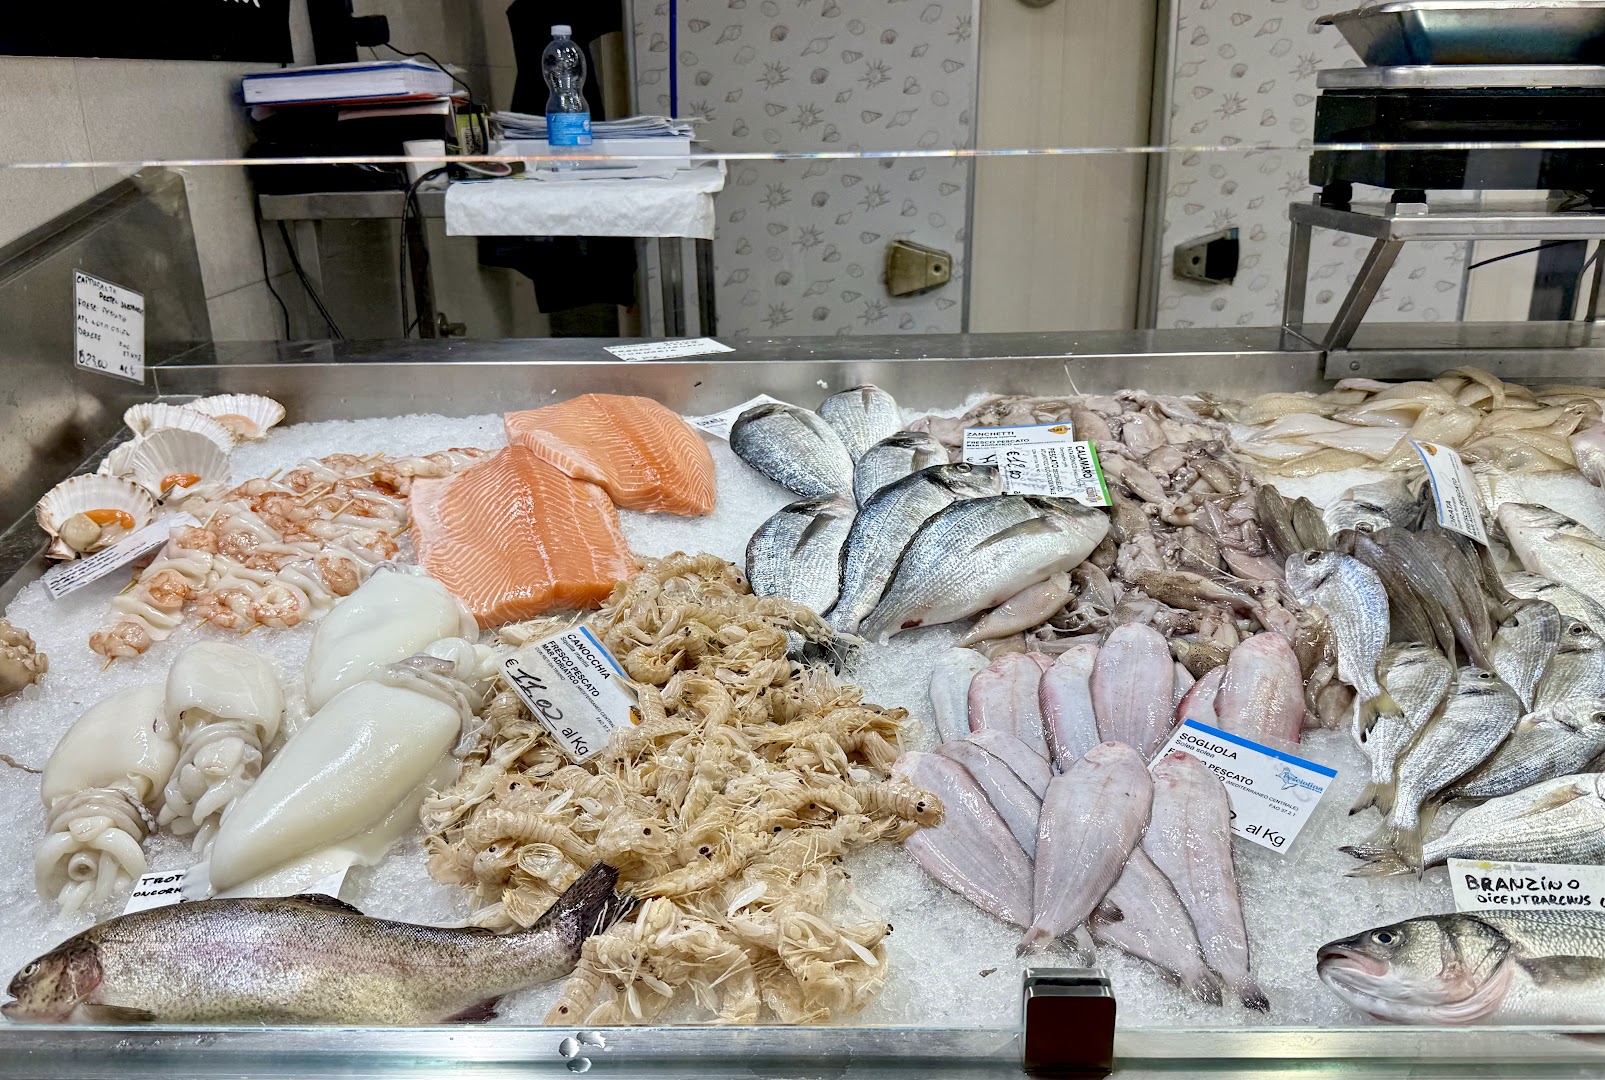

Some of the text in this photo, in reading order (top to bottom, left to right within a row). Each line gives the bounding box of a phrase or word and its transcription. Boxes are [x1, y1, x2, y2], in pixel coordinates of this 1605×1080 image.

[1048, 447, 1059, 469] PESCATO
[1075, 445, 1093, 479] CALAMARO
[541, 643, 555, 657] MAR
[551, 656, 579, 685] ADRIATICO
[547, 640, 600, 697] FRESCO PESCATO
[566, 633, 611, 680] CANOCCHIA
[505, 658, 519, 668] €
[561, 727, 578, 739] al
[570, 736, 589, 756] Kg
[1175, 739, 1196, 752] Solea
[1197, 746, 1215, 759] solea
[1179, 732, 1238, 760] SOGLIOLA
[1208, 762, 1254, 786] PESCATO
[1225, 780, 1299, 812] (MEDITERRANEO CENTRALE)
[1268, 803, 1280, 811] FAO
[1245, 823, 1286, 848] al Kg
[142, 874, 183, 886] TROT
